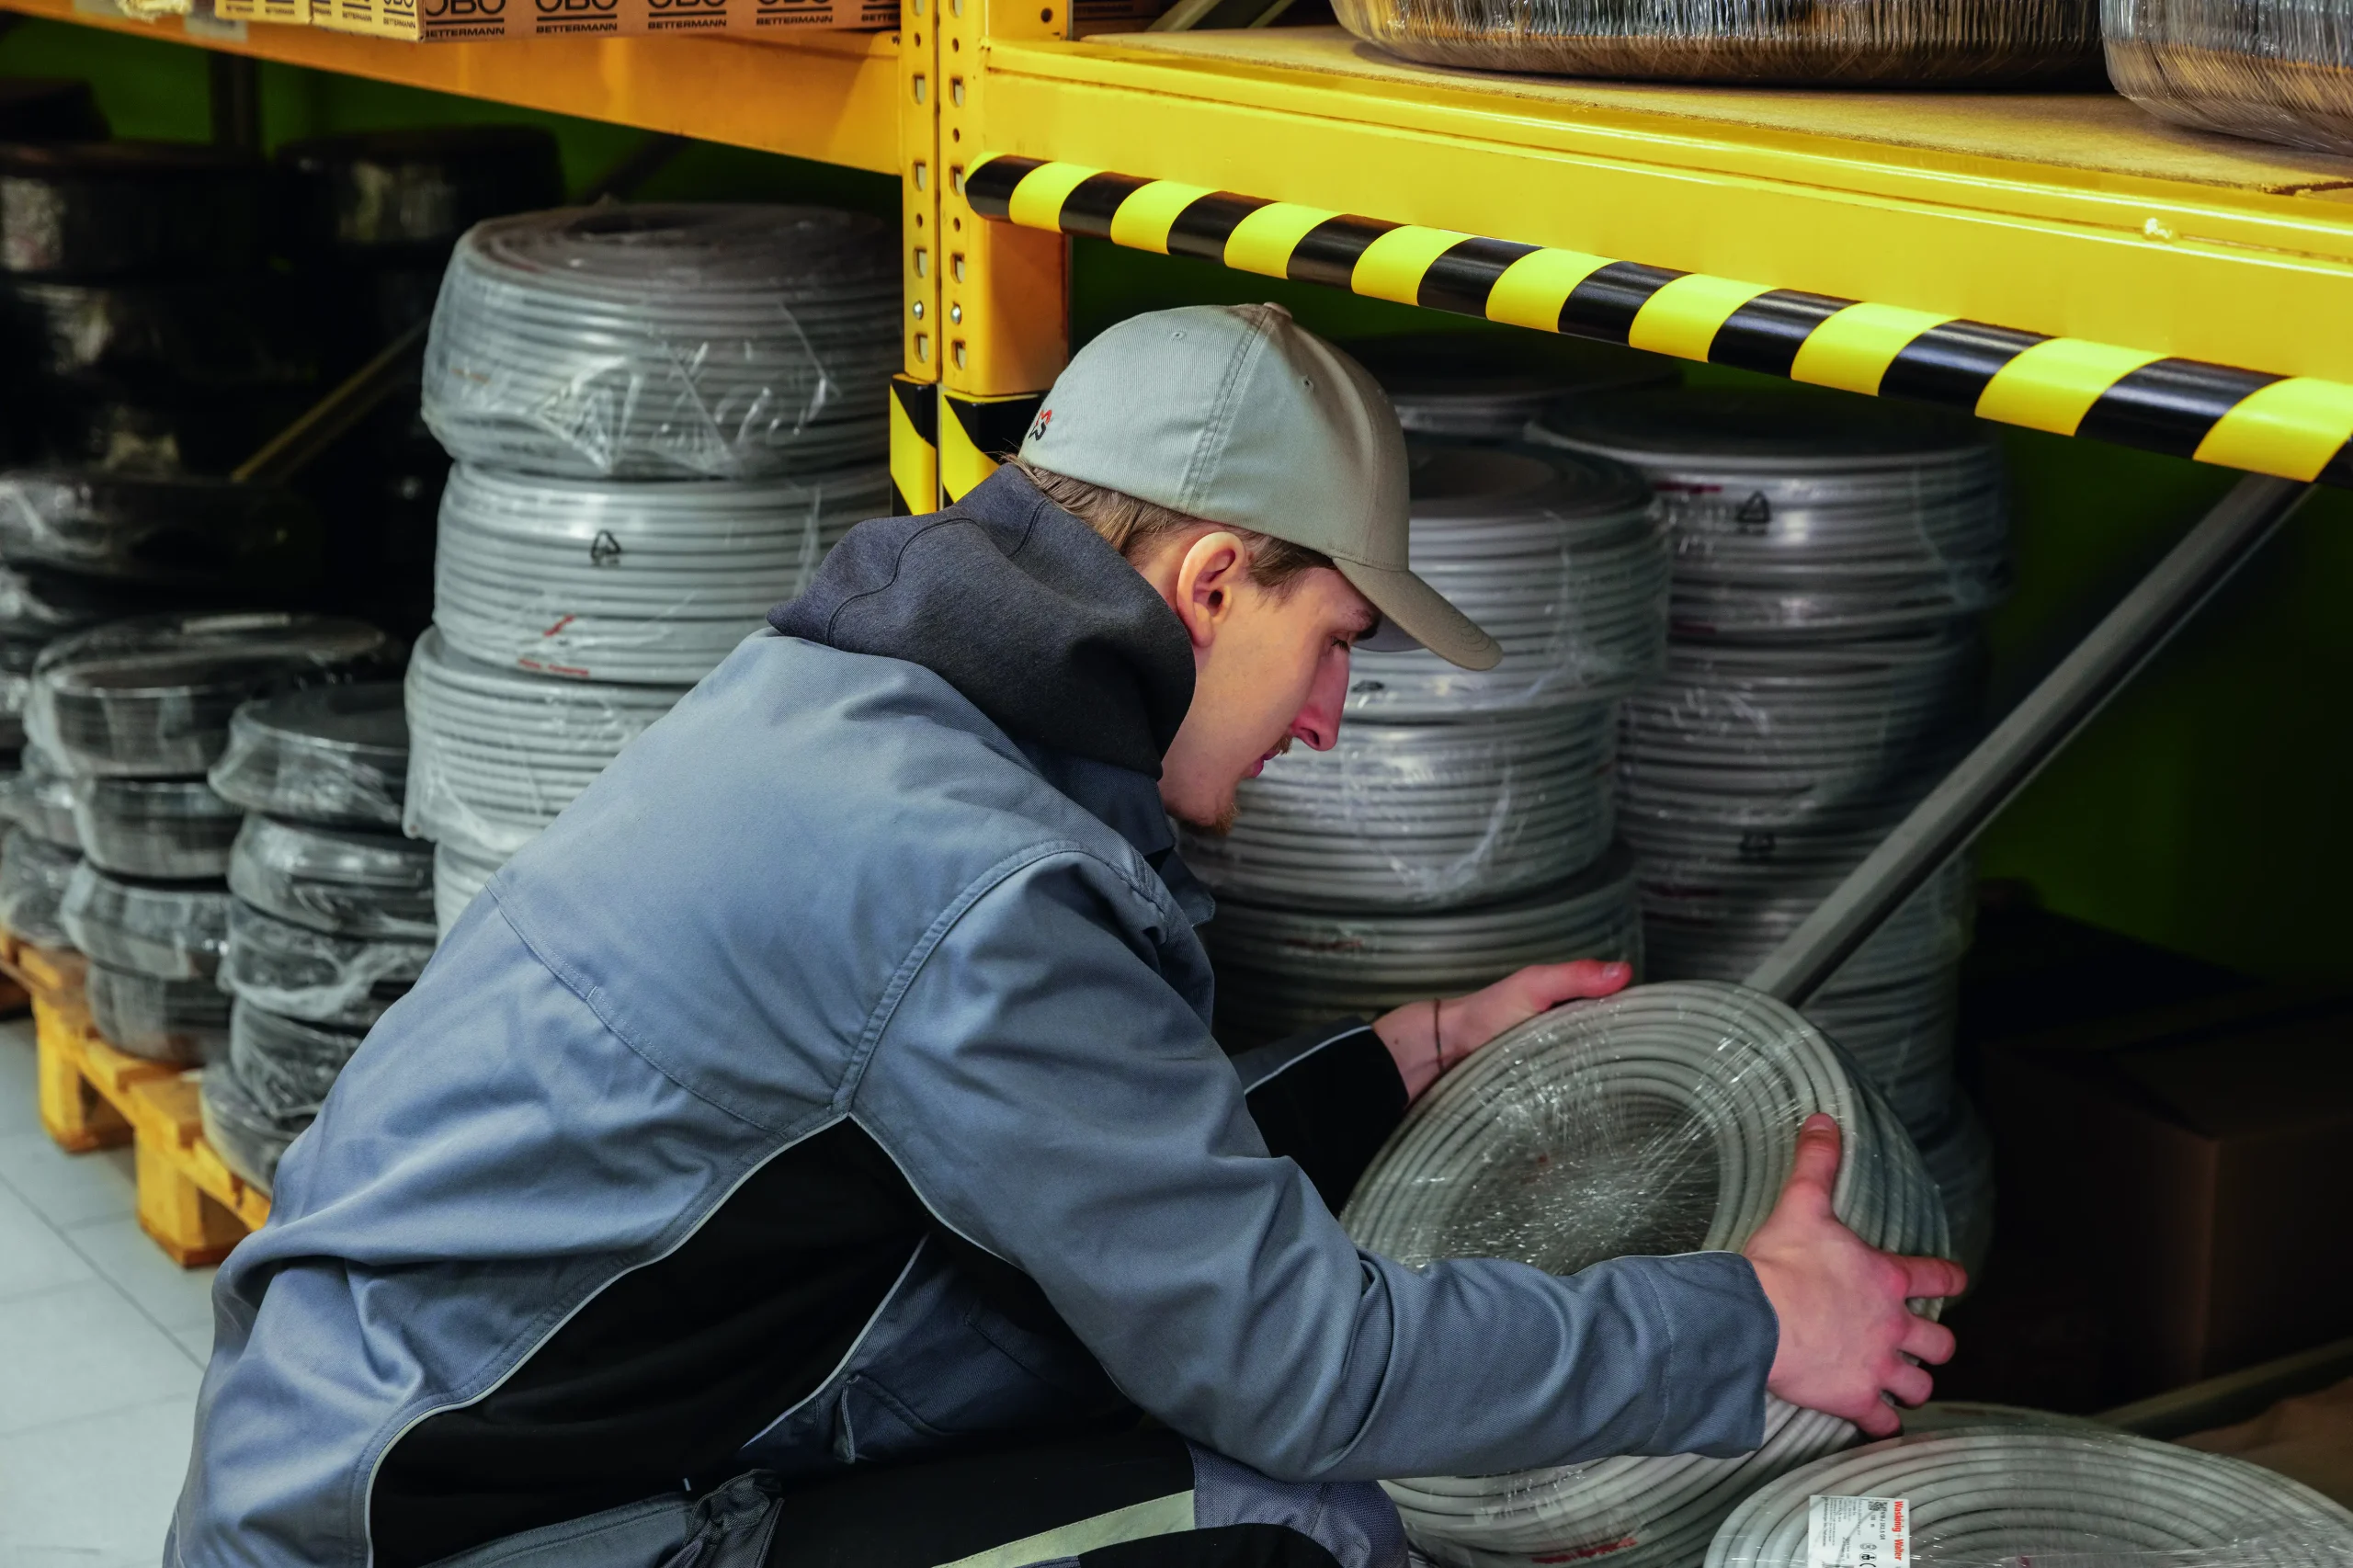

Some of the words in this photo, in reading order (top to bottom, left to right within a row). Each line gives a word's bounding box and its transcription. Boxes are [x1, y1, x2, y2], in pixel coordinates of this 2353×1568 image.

[648, 18, 726, 29] BETTERMANN
[756, 15, 832, 26] BETTERMANN
[536, 23, 617, 33] BETTERMANN
[1894, 1539, 1904, 1561] Walter
